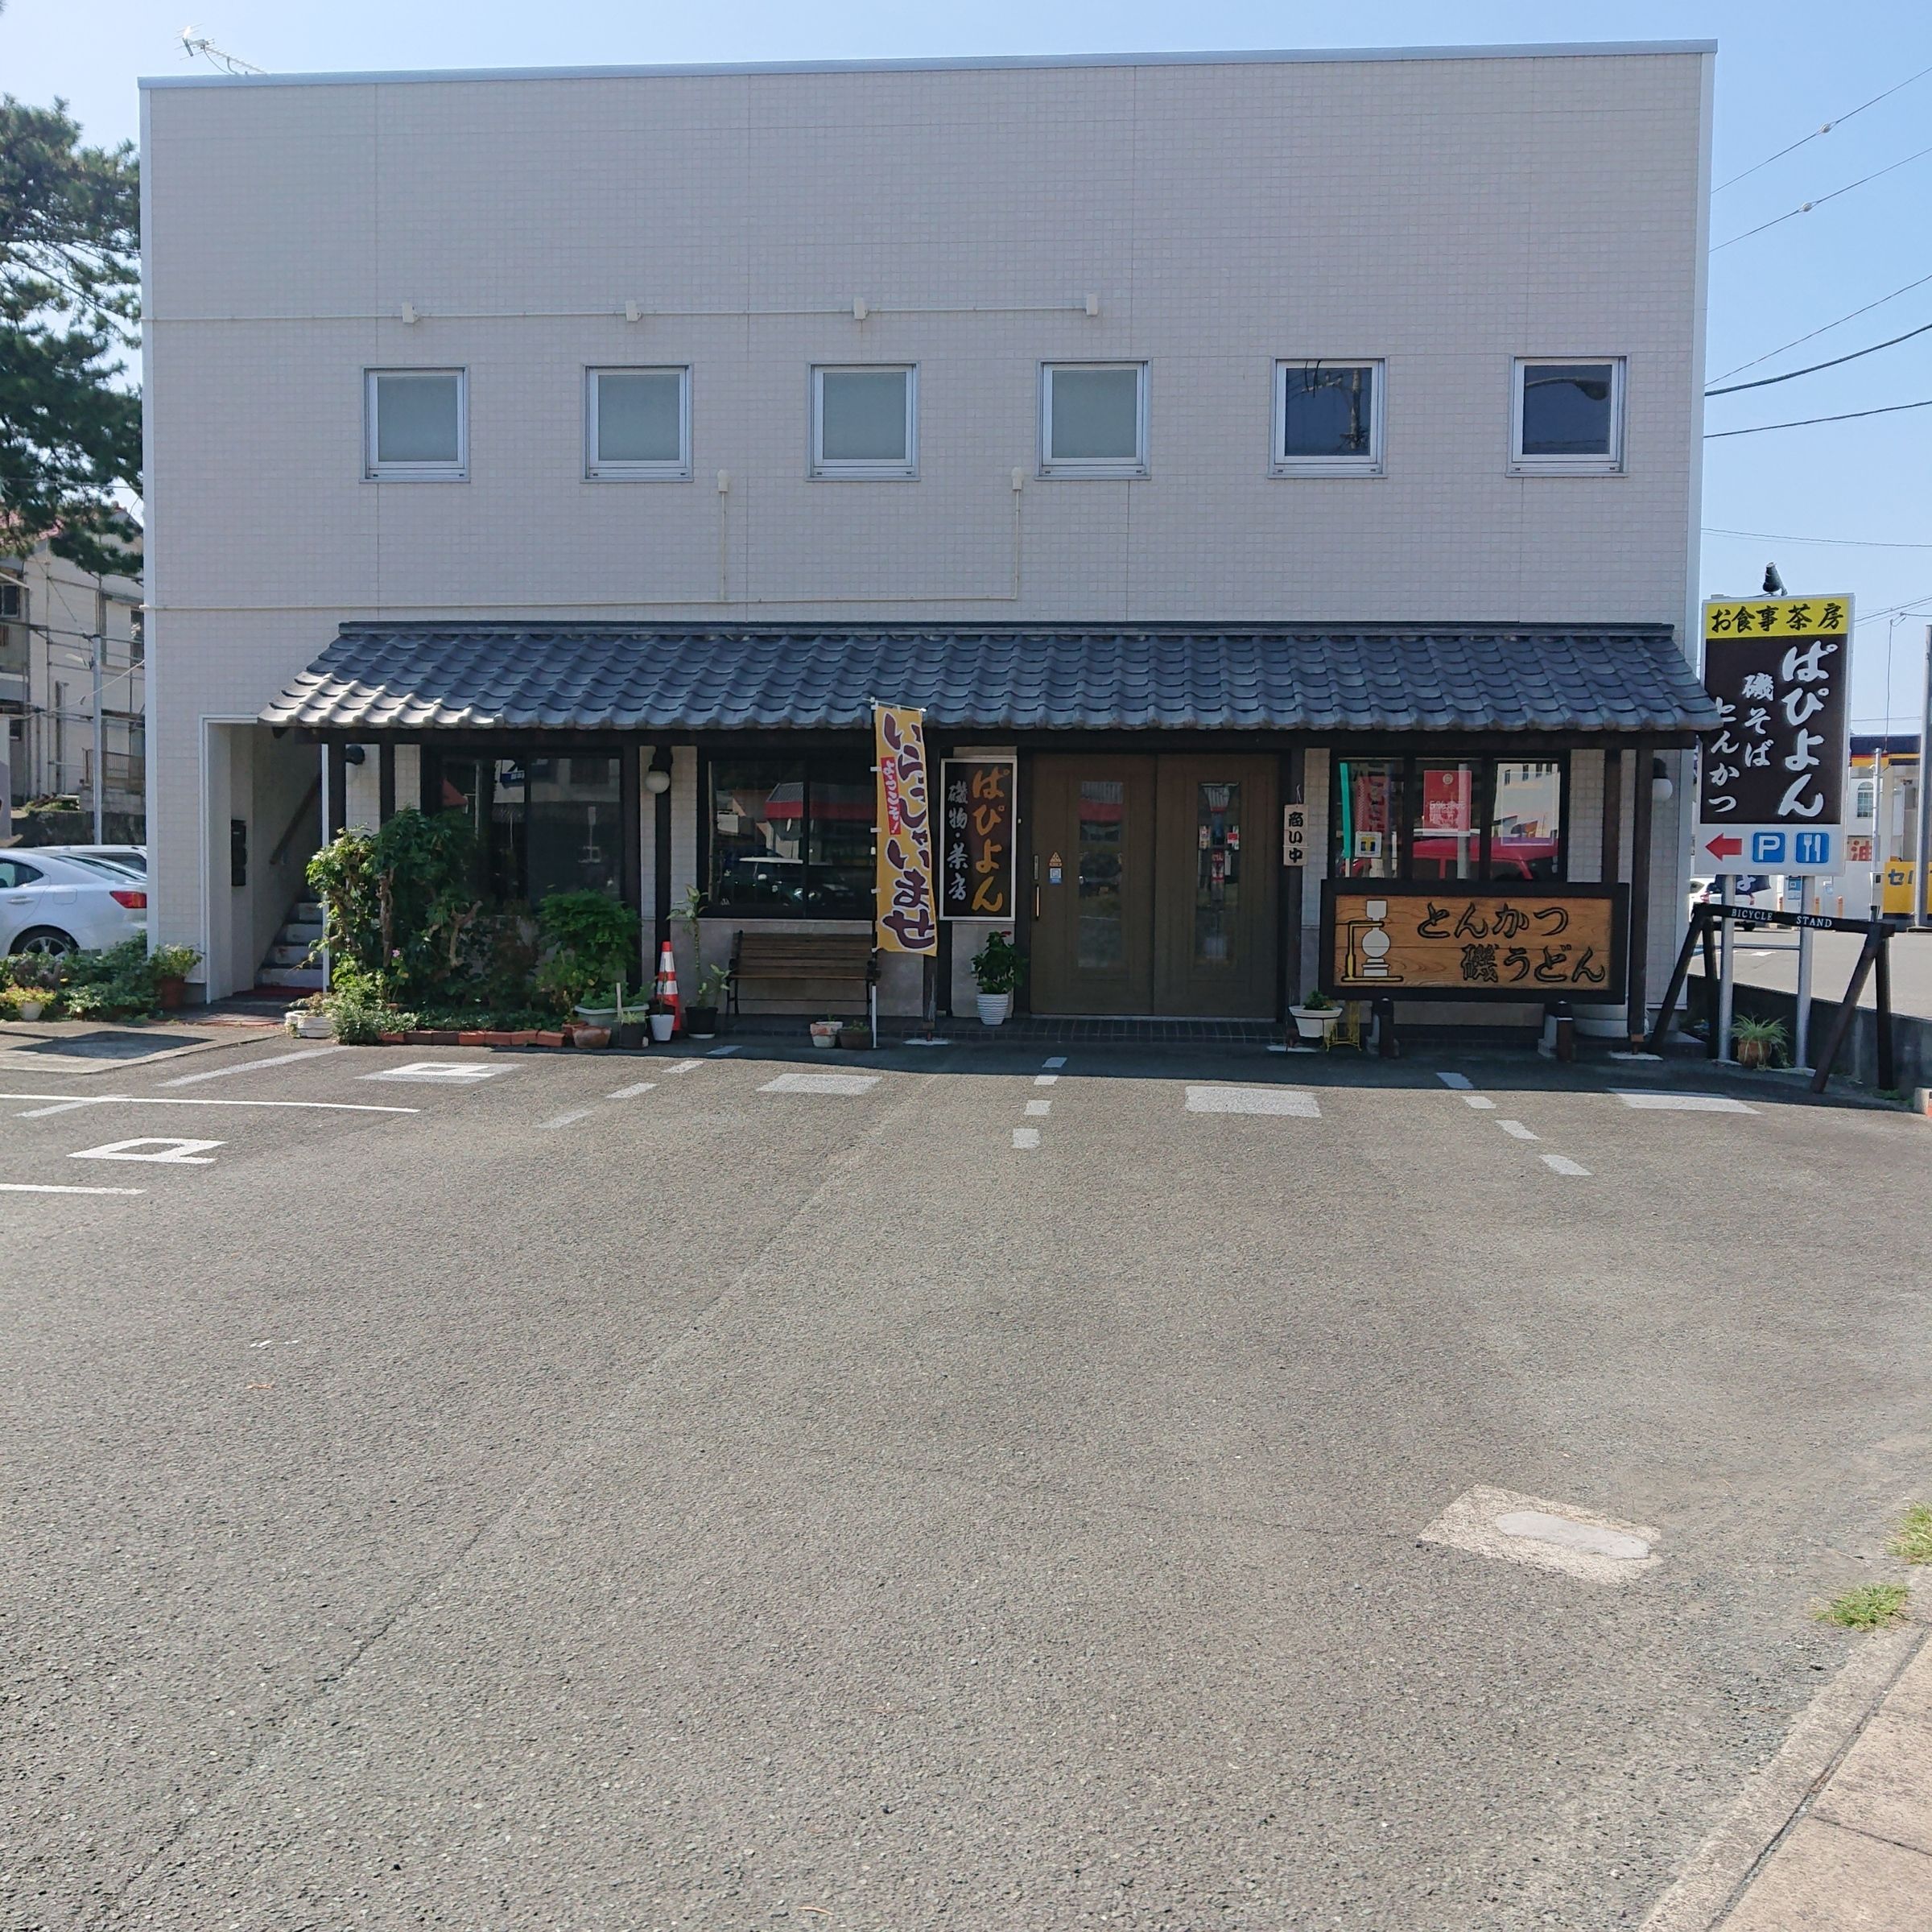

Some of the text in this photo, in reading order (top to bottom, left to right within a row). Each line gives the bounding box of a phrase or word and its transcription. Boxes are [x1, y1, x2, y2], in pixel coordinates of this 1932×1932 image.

[1711, 604, 1843, 633] お食事茶房
[1742, 672, 1774, 767] 磯そば
[1777, 641, 1839, 817] ぱぴよん
[1708, 697, 1740, 813] とんかつ
[972, 766, 1009, 912] ぱぴよん
[1288, 811, 1304, 864] 商い中
[1761, 836, 1781, 859] P
[1417, 901, 1569, 939] とんかつ
[1731, 908, 1833, 928] BICYCLE STAND
[1460, 943, 1605, 983] 磯うどん
